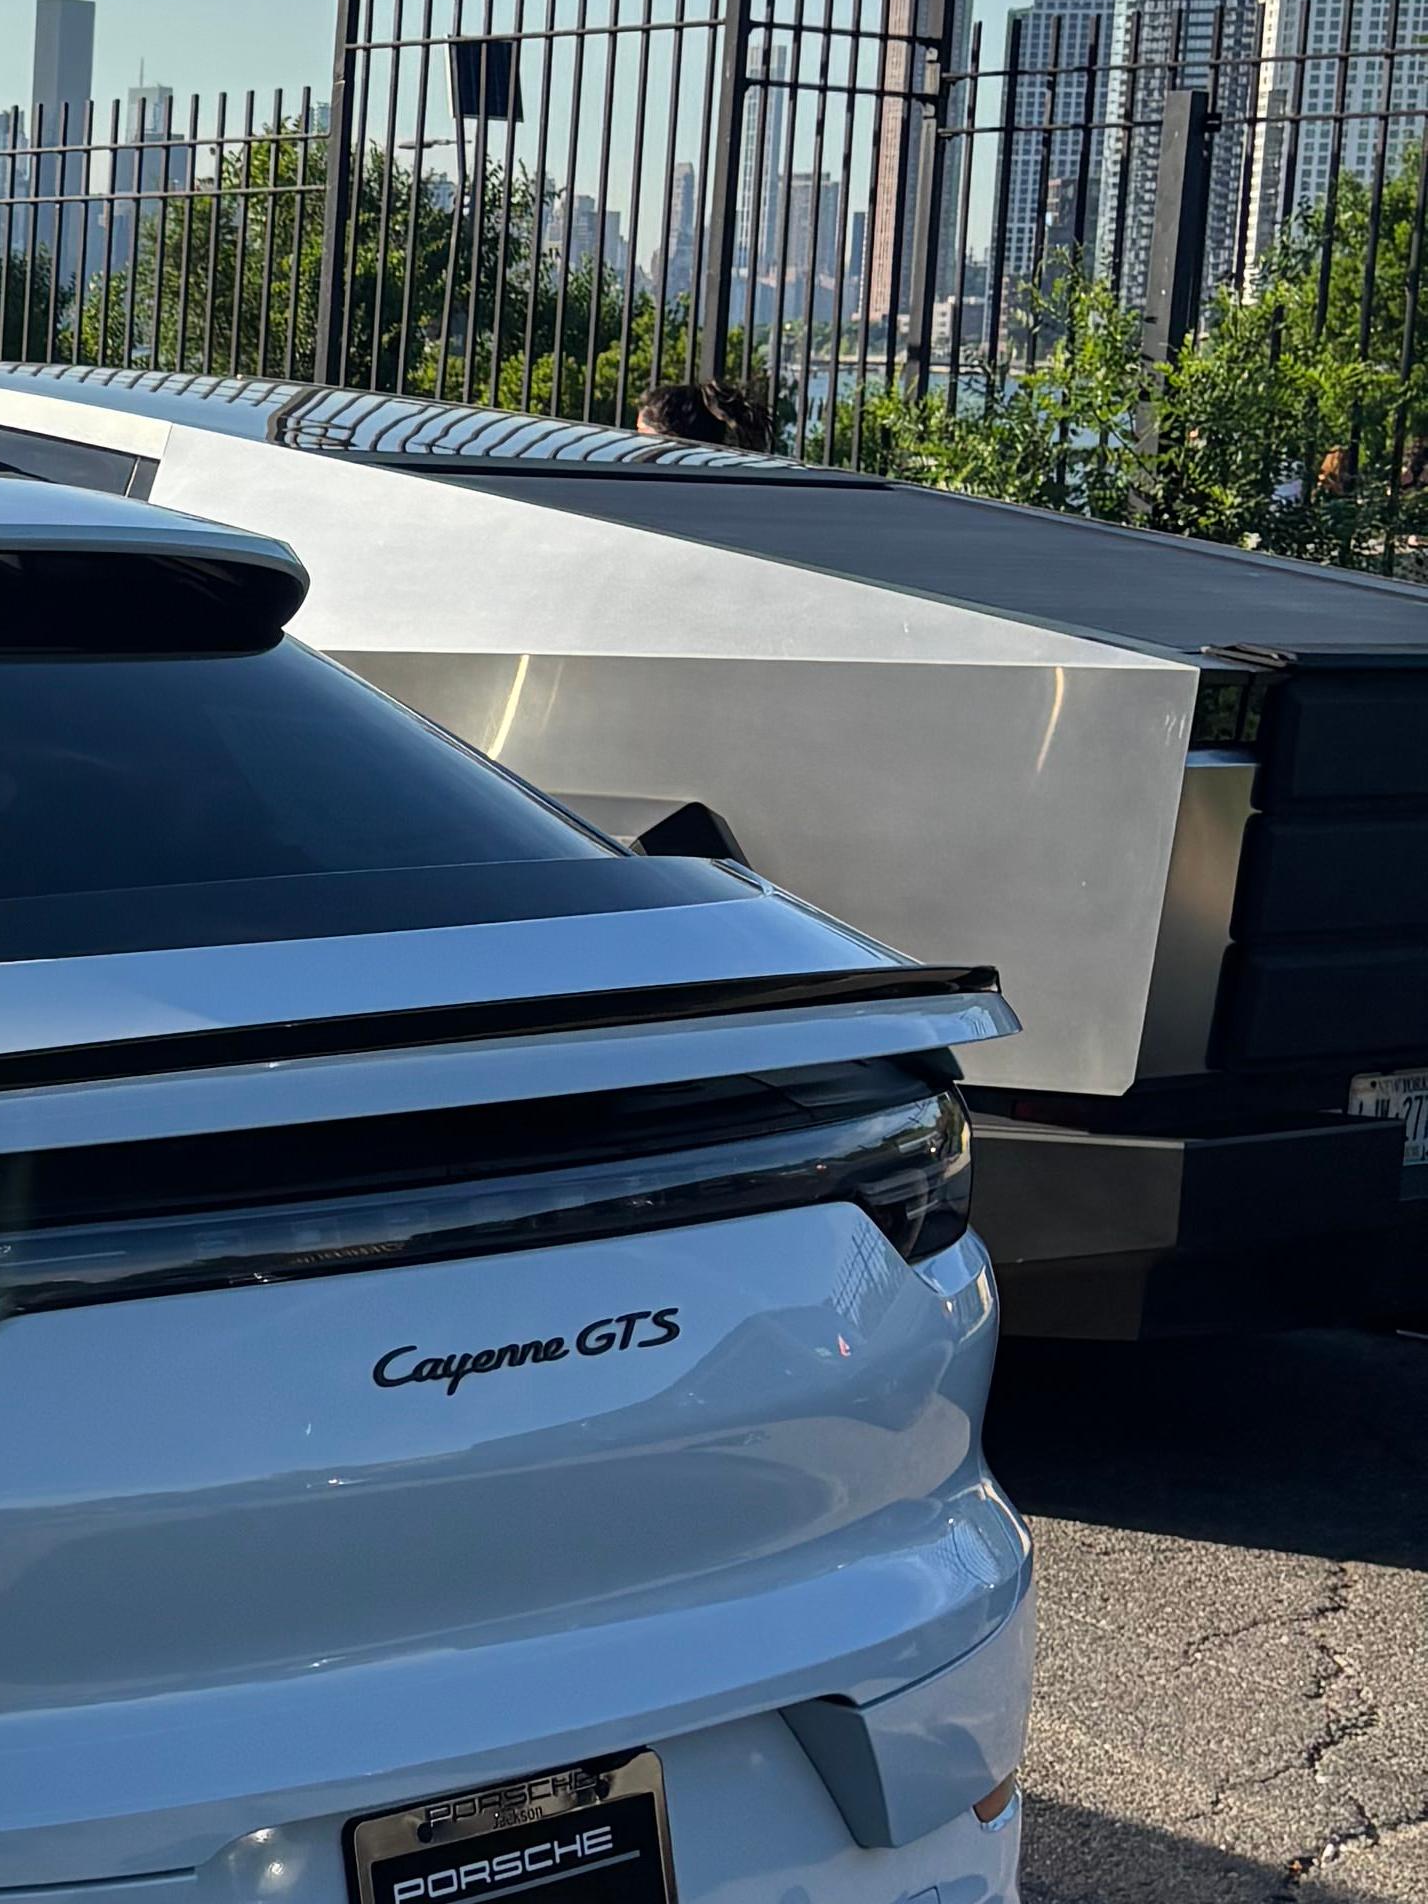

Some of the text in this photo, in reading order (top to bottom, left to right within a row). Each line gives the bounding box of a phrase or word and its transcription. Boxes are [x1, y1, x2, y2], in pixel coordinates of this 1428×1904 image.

[373, 1307, 680, 1396] Cayenne GTS
[425, 1768, 596, 1827] PORSCHE
[493, 1805, 544, 1830] Jackson
